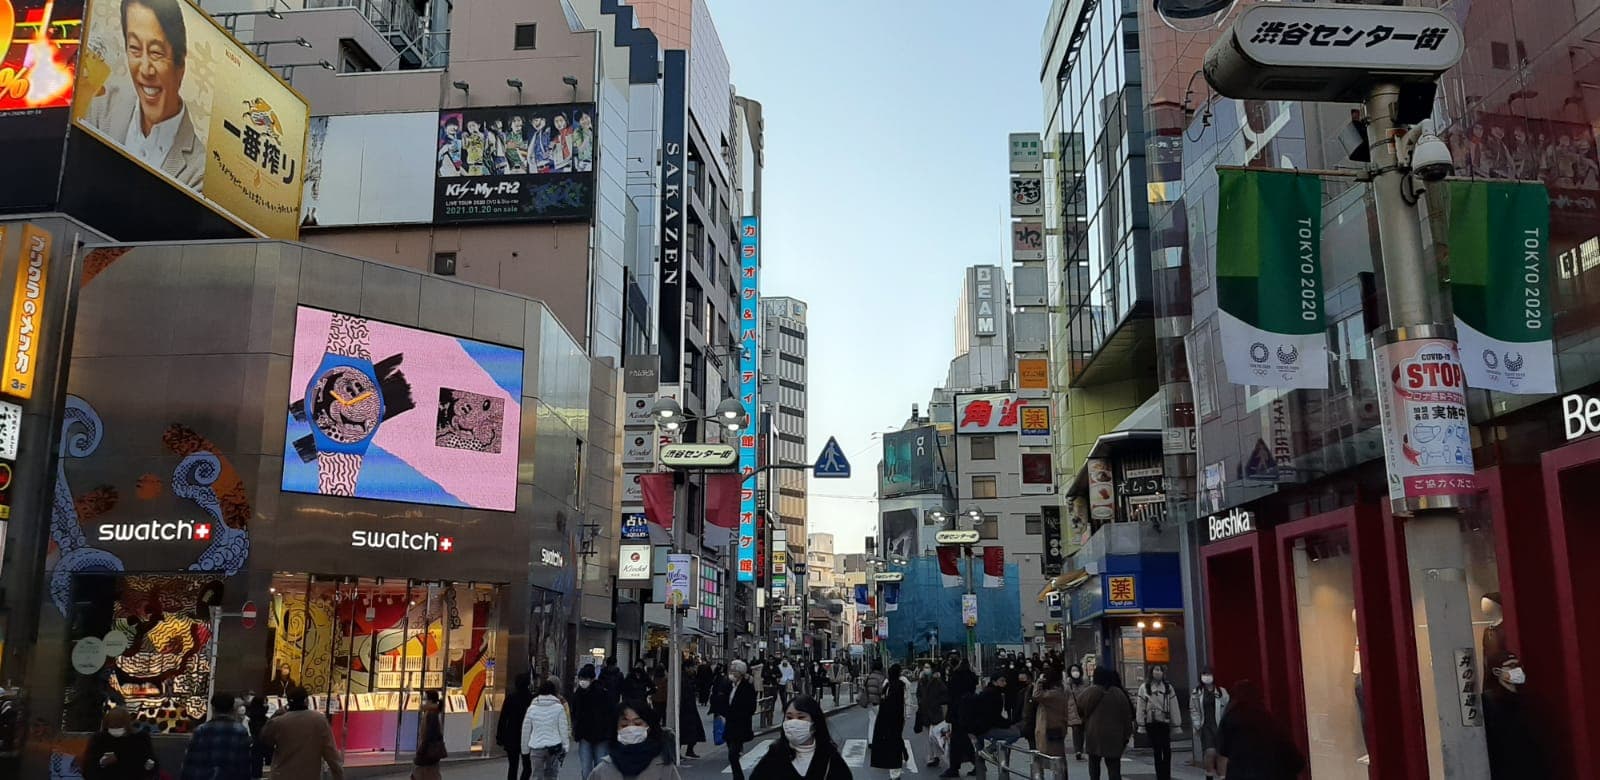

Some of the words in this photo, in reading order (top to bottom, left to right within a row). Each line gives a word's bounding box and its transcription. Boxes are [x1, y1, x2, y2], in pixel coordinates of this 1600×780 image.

[1250, 21, 1448, 51] 渋谷センター街
[223, 119, 295, 184] 一番搾り
[445, 180, 520, 198] Kis-My-Ft2
[446, 206, 491, 214] 2021.01.20
[664, 142, 680, 285] SAKAZEN
[1297, 217, 1314, 275] TOKYO
[1523, 228, 1540, 283] TOKYO
[977, 267, 994, 333] BEAM
[1301, 277, 1317, 321] 2020
[1525, 286, 1541, 329] 2020
[742, 225, 756, 447] カラオケ&パティー館
[1407, 362, 1462, 389] STOP
[1024, 409, 1045, 428] 薬
[1432, 405, 1466, 420] 実施中
[664, 449, 733, 459] 渋谷センター街
[98, 519, 193, 541] swatch
[626, 515, 647, 527] 占い
[739, 465, 754, 573] カラオケ館
[1208, 507, 1250, 541] Bershka
[352, 530, 438, 551] swatch
[1111, 578, 1131, 599] 薬
